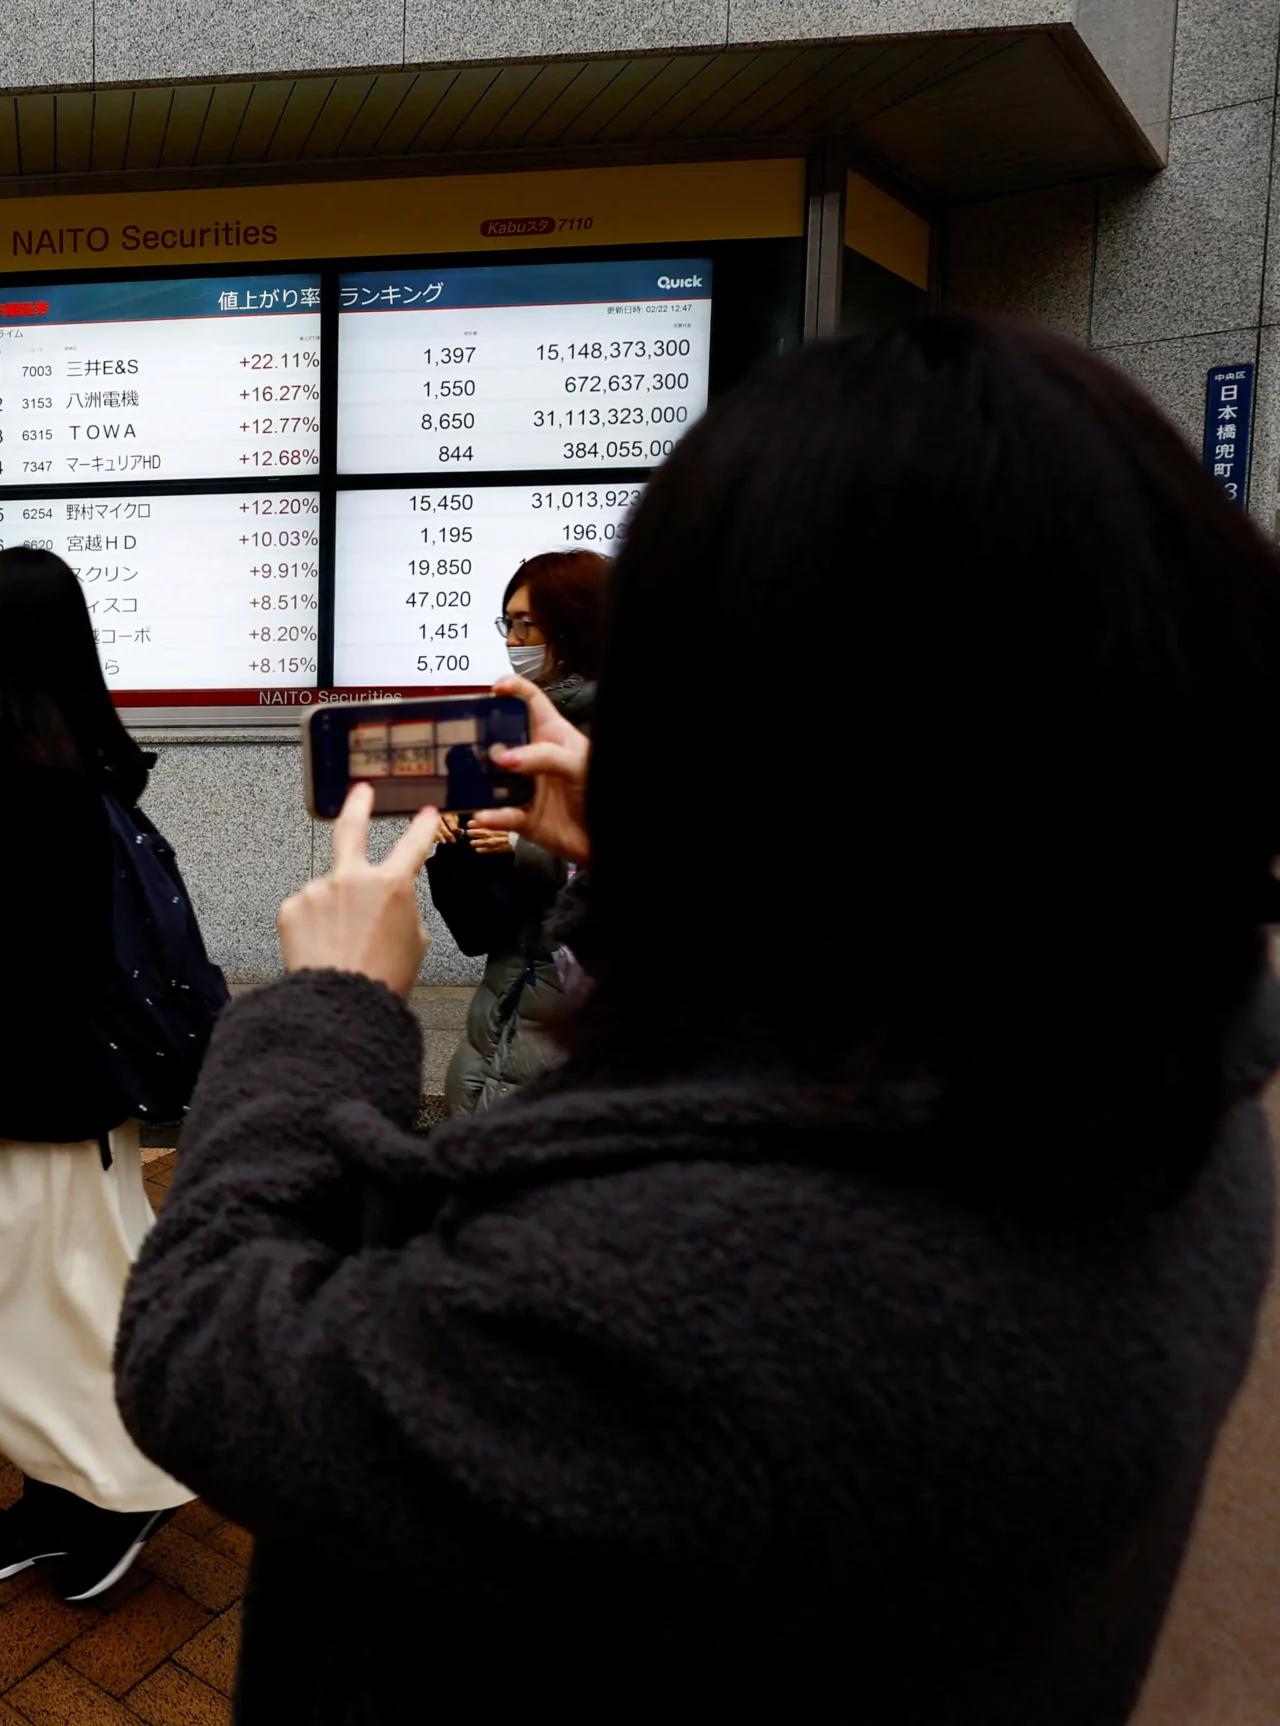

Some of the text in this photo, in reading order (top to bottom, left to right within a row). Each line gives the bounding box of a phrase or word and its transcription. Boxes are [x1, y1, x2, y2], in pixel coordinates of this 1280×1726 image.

[558, 217, 594, 231] 7110
[13, 221, 278, 256] NAITO Securities
[645, 305, 668, 313] 02/22
[670, 304, 693, 312] 12:47
[423, 347, 477, 367] 1,397
[536, 339, 691, 362] 15,148,373,300
[66, 359, 139, 378] 三井E&S
[239, 352, 320, 370] +22.11%
[21, 365, 53, 378] 7003
[1214, 371, 1246, 382] 中央区
[423, 380, 476, 399] 1,550
[565, 373, 689, 394] 672,637,300
[66, 390, 139, 409] 八洲電機
[239, 384, 320, 402] +16.27%
[22, 397, 53, 410] 3153
[239, 416, 320, 434] +12.77%
[421, 412, 475, 431] 8,650
[533, 406, 688, 430] 31,113,323,000
[22, 429, 53, 441] 6315
[239, 449, 319, 467] +12.68%
[438, 445, 474, 462] 844
[563, 440, 680, 460] 384,055,00
[22, 460, 53, 473] 7347
[66, 454, 161, 473] マーキュリアHD
[66, 503, 151, 521] 野村マイクロ
[239, 498, 319, 516] +12.20%
[409, 494, 474, 513] 15,450
[23, 508, 53, 520] 6254
[239, 530, 318, 548] +10.03%
[421, 526, 473, 545] 1,195
[249, 562, 318, 580] +9.91%
[408, 559, 472, 578] 19,850
[249, 594, 318, 611] +8.51%
[405, 591, 471, 609] 47,020
[249, 625, 317, 643] +8.20%
[419, 623, 469, 642] 1,451
[249, 657, 317, 675] +8.15%
[417, 655, 470, 674] 5,700
[259, 690, 312, 705] NAITO
